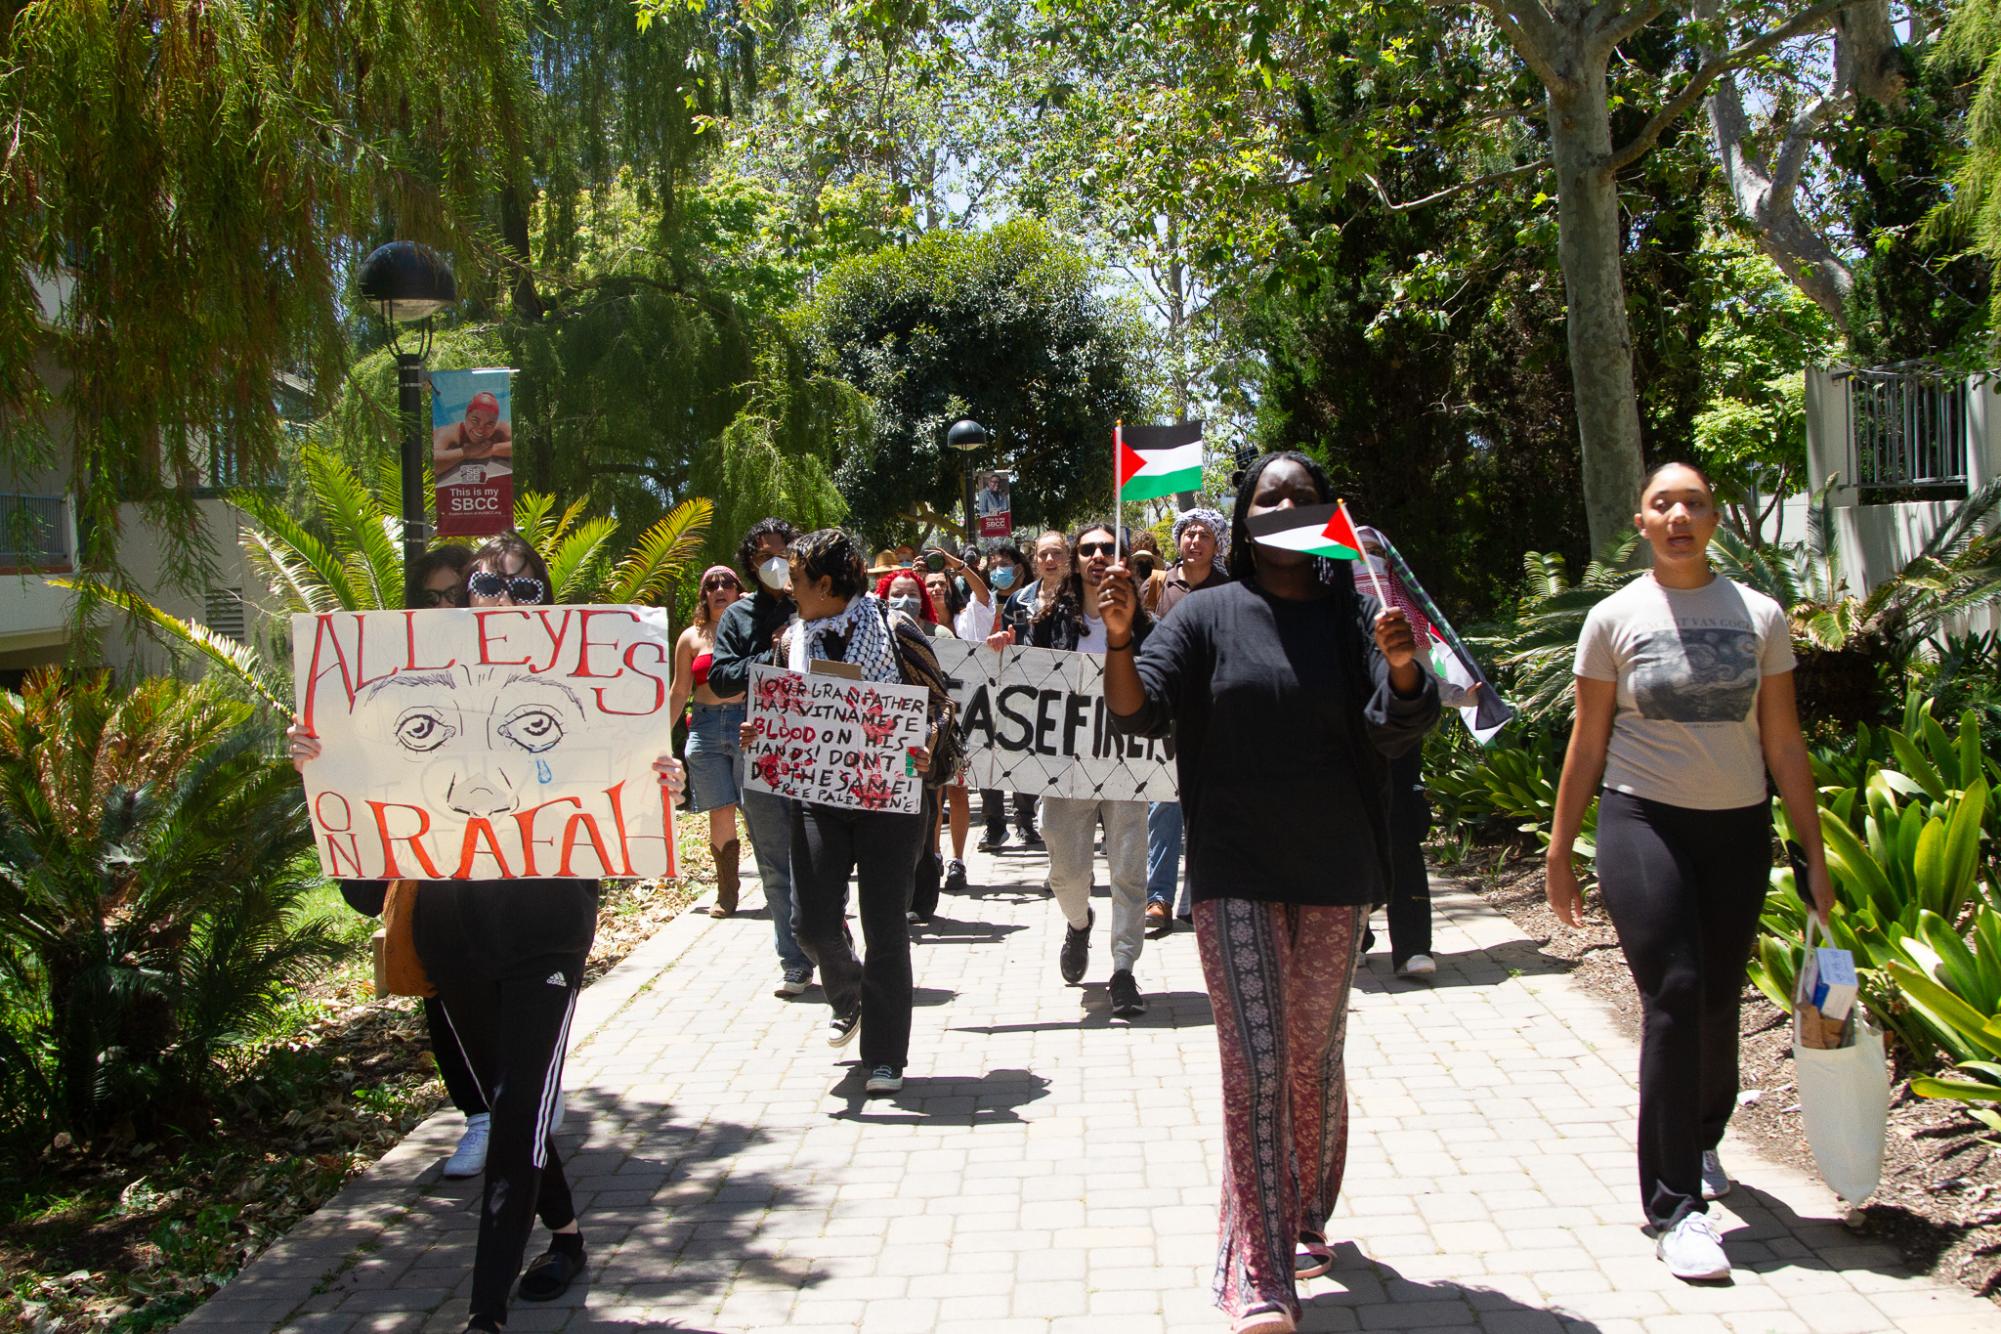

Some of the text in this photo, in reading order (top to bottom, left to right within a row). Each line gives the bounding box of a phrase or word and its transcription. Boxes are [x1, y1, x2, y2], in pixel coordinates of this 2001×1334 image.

[450, 487, 499, 498] This is my
[451, 497, 498, 511] SBCC
[304, 609, 668, 739] ALL EYES
[755, 671, 807, 697] YOUR
[753, 697, 791, 714] HAS
[944, 679, 1144, 759] ASEFI
[752, 716, 909, 752] BLOOD ON HIS
[748, 742, 896, 772] HANDS! DON'T
[751, 761, 912, 799] DO THE SAME!
[771, 780, 813, 799] FREE
[315, 776, 679, 880] ON RAFAH
